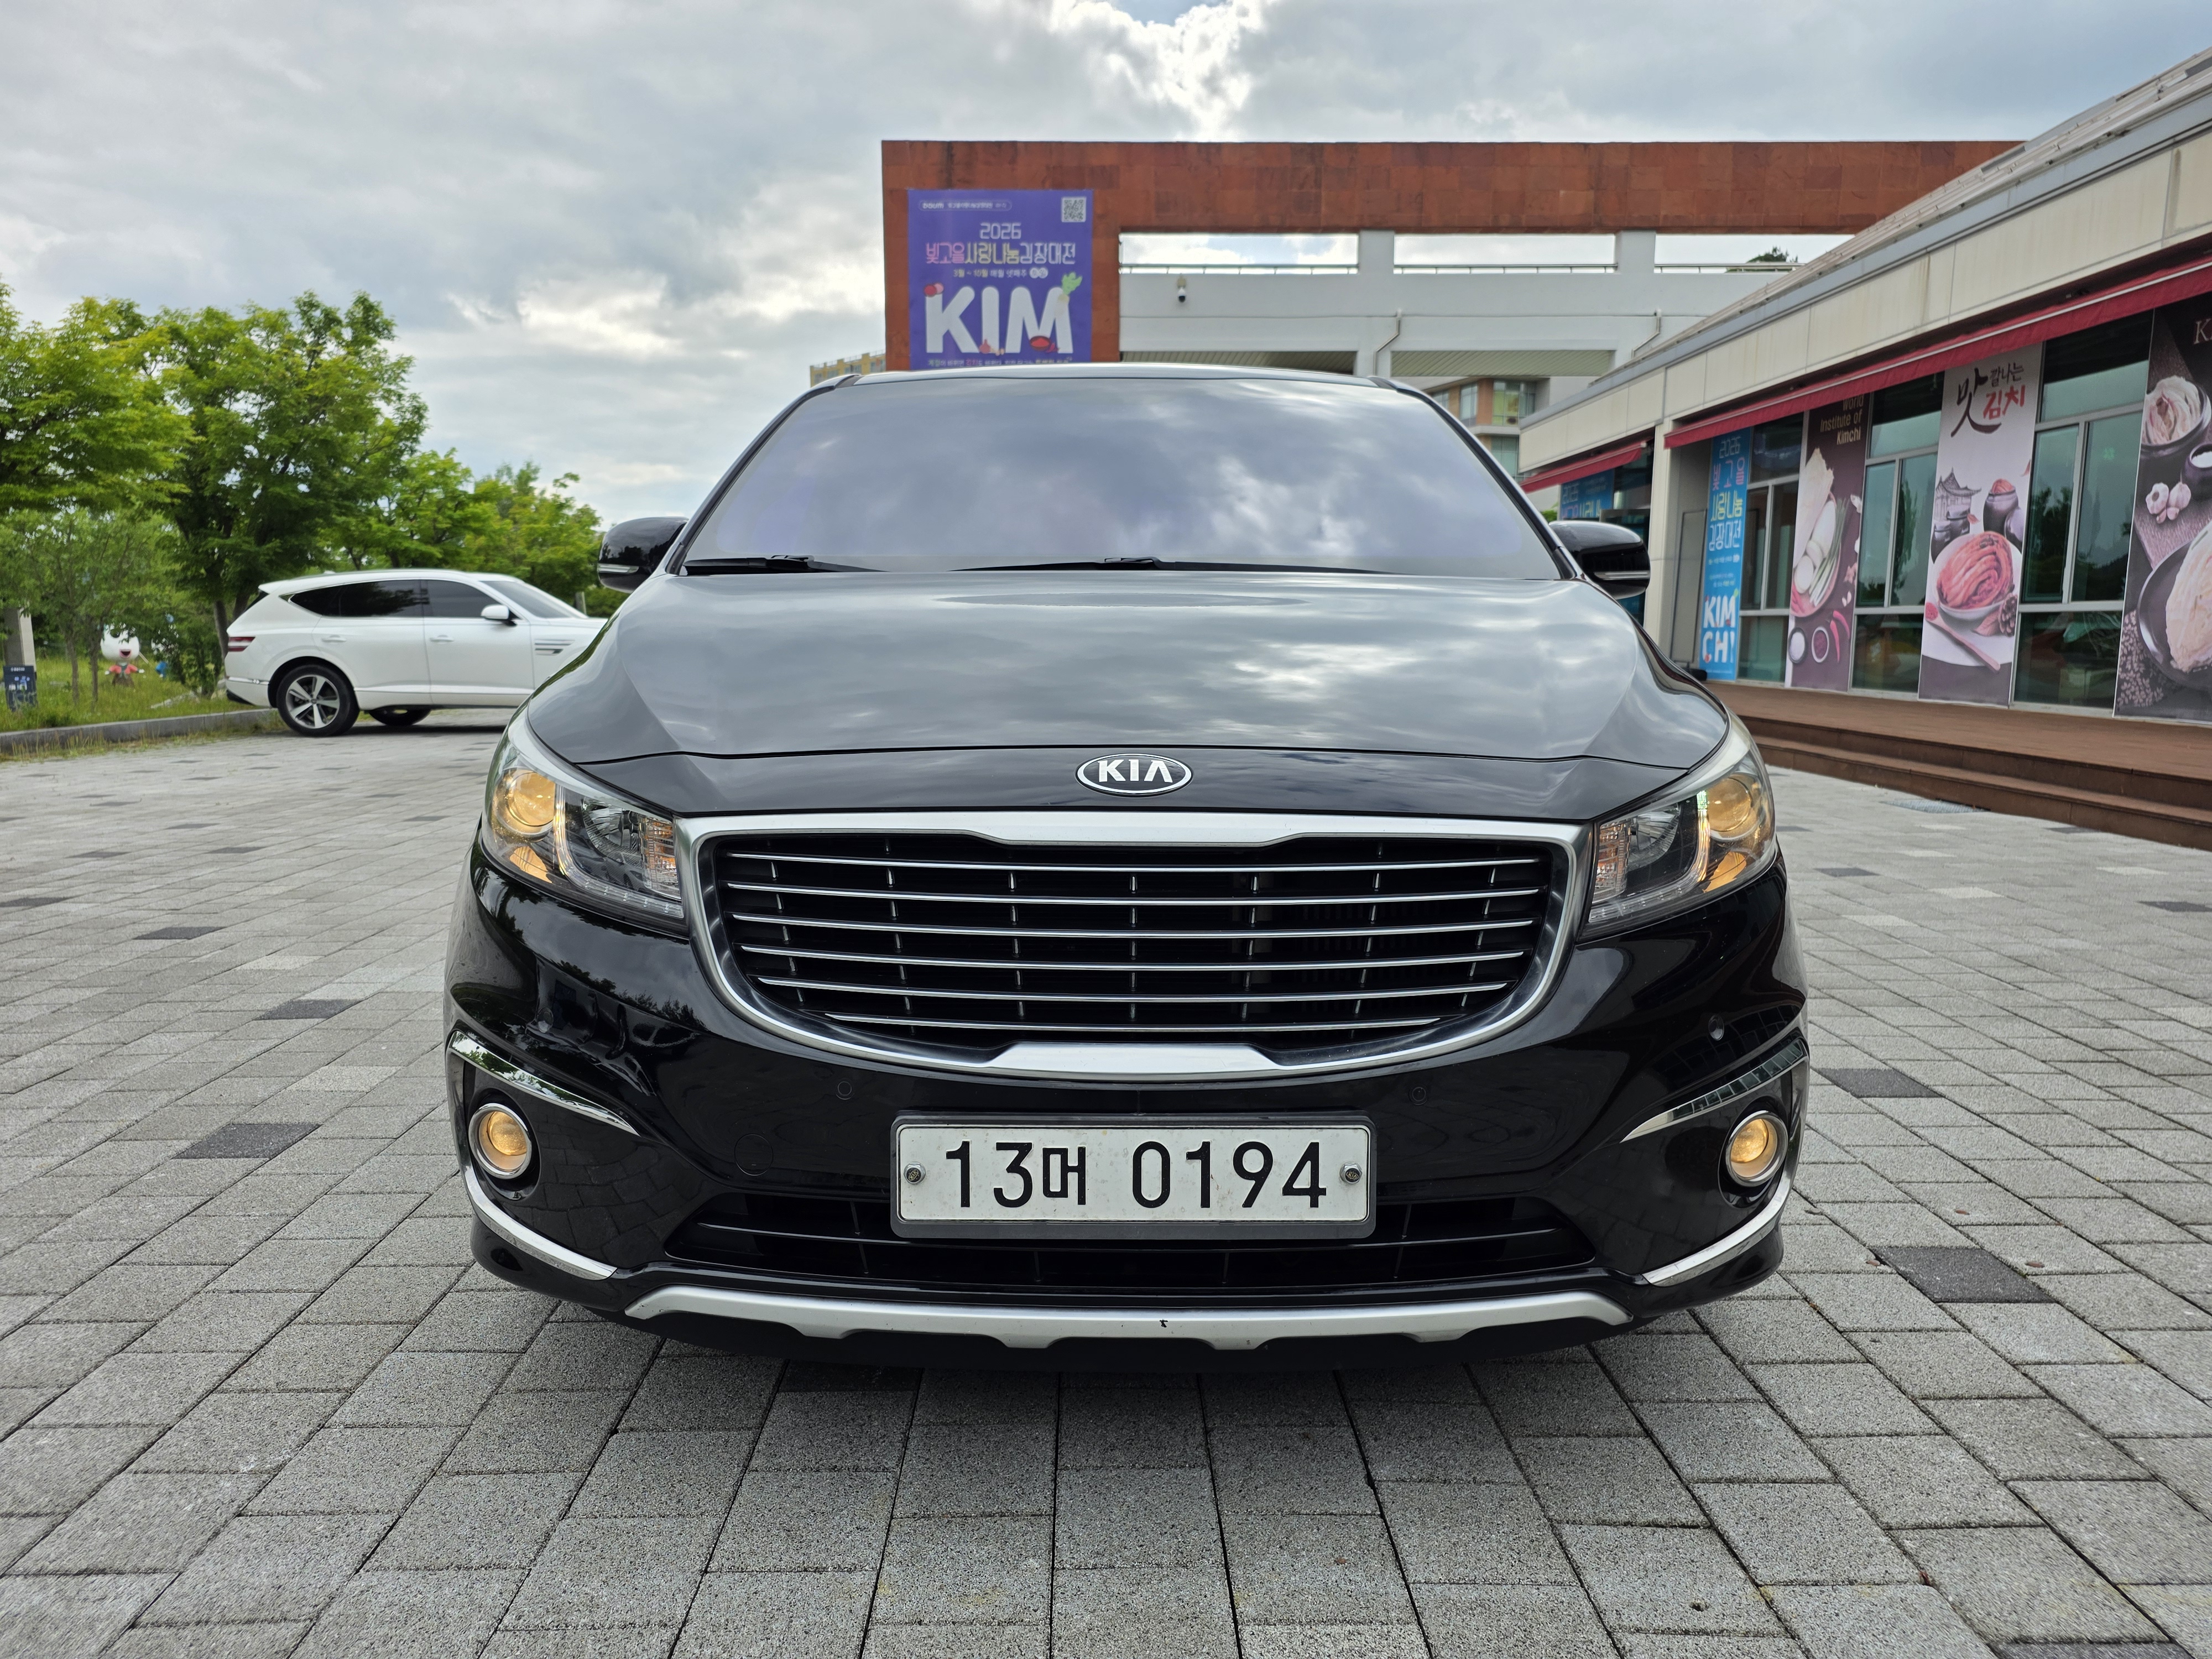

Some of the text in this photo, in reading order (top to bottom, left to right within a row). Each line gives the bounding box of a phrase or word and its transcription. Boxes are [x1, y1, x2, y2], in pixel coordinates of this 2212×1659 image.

[979, 222, 1022, 239] 2026
[925, 285, 1074, 354] KIM
[1983, 385, 2026, 420] 김치
[1820, 409, 1863, 432] Institute of
[1837, 425, 1861, 445] Kimchi
[1719, 436, 1741, 459] 2026
[1710, 490, 1744, 521] 사랑나눔
[1709, 519, 1741, 551] 김장대전
[1703, 595, 1736, 629] KIM
[1097, 759, 1173, 783] KIA
[946, 1140, 1327, 1208] 13머 0194
